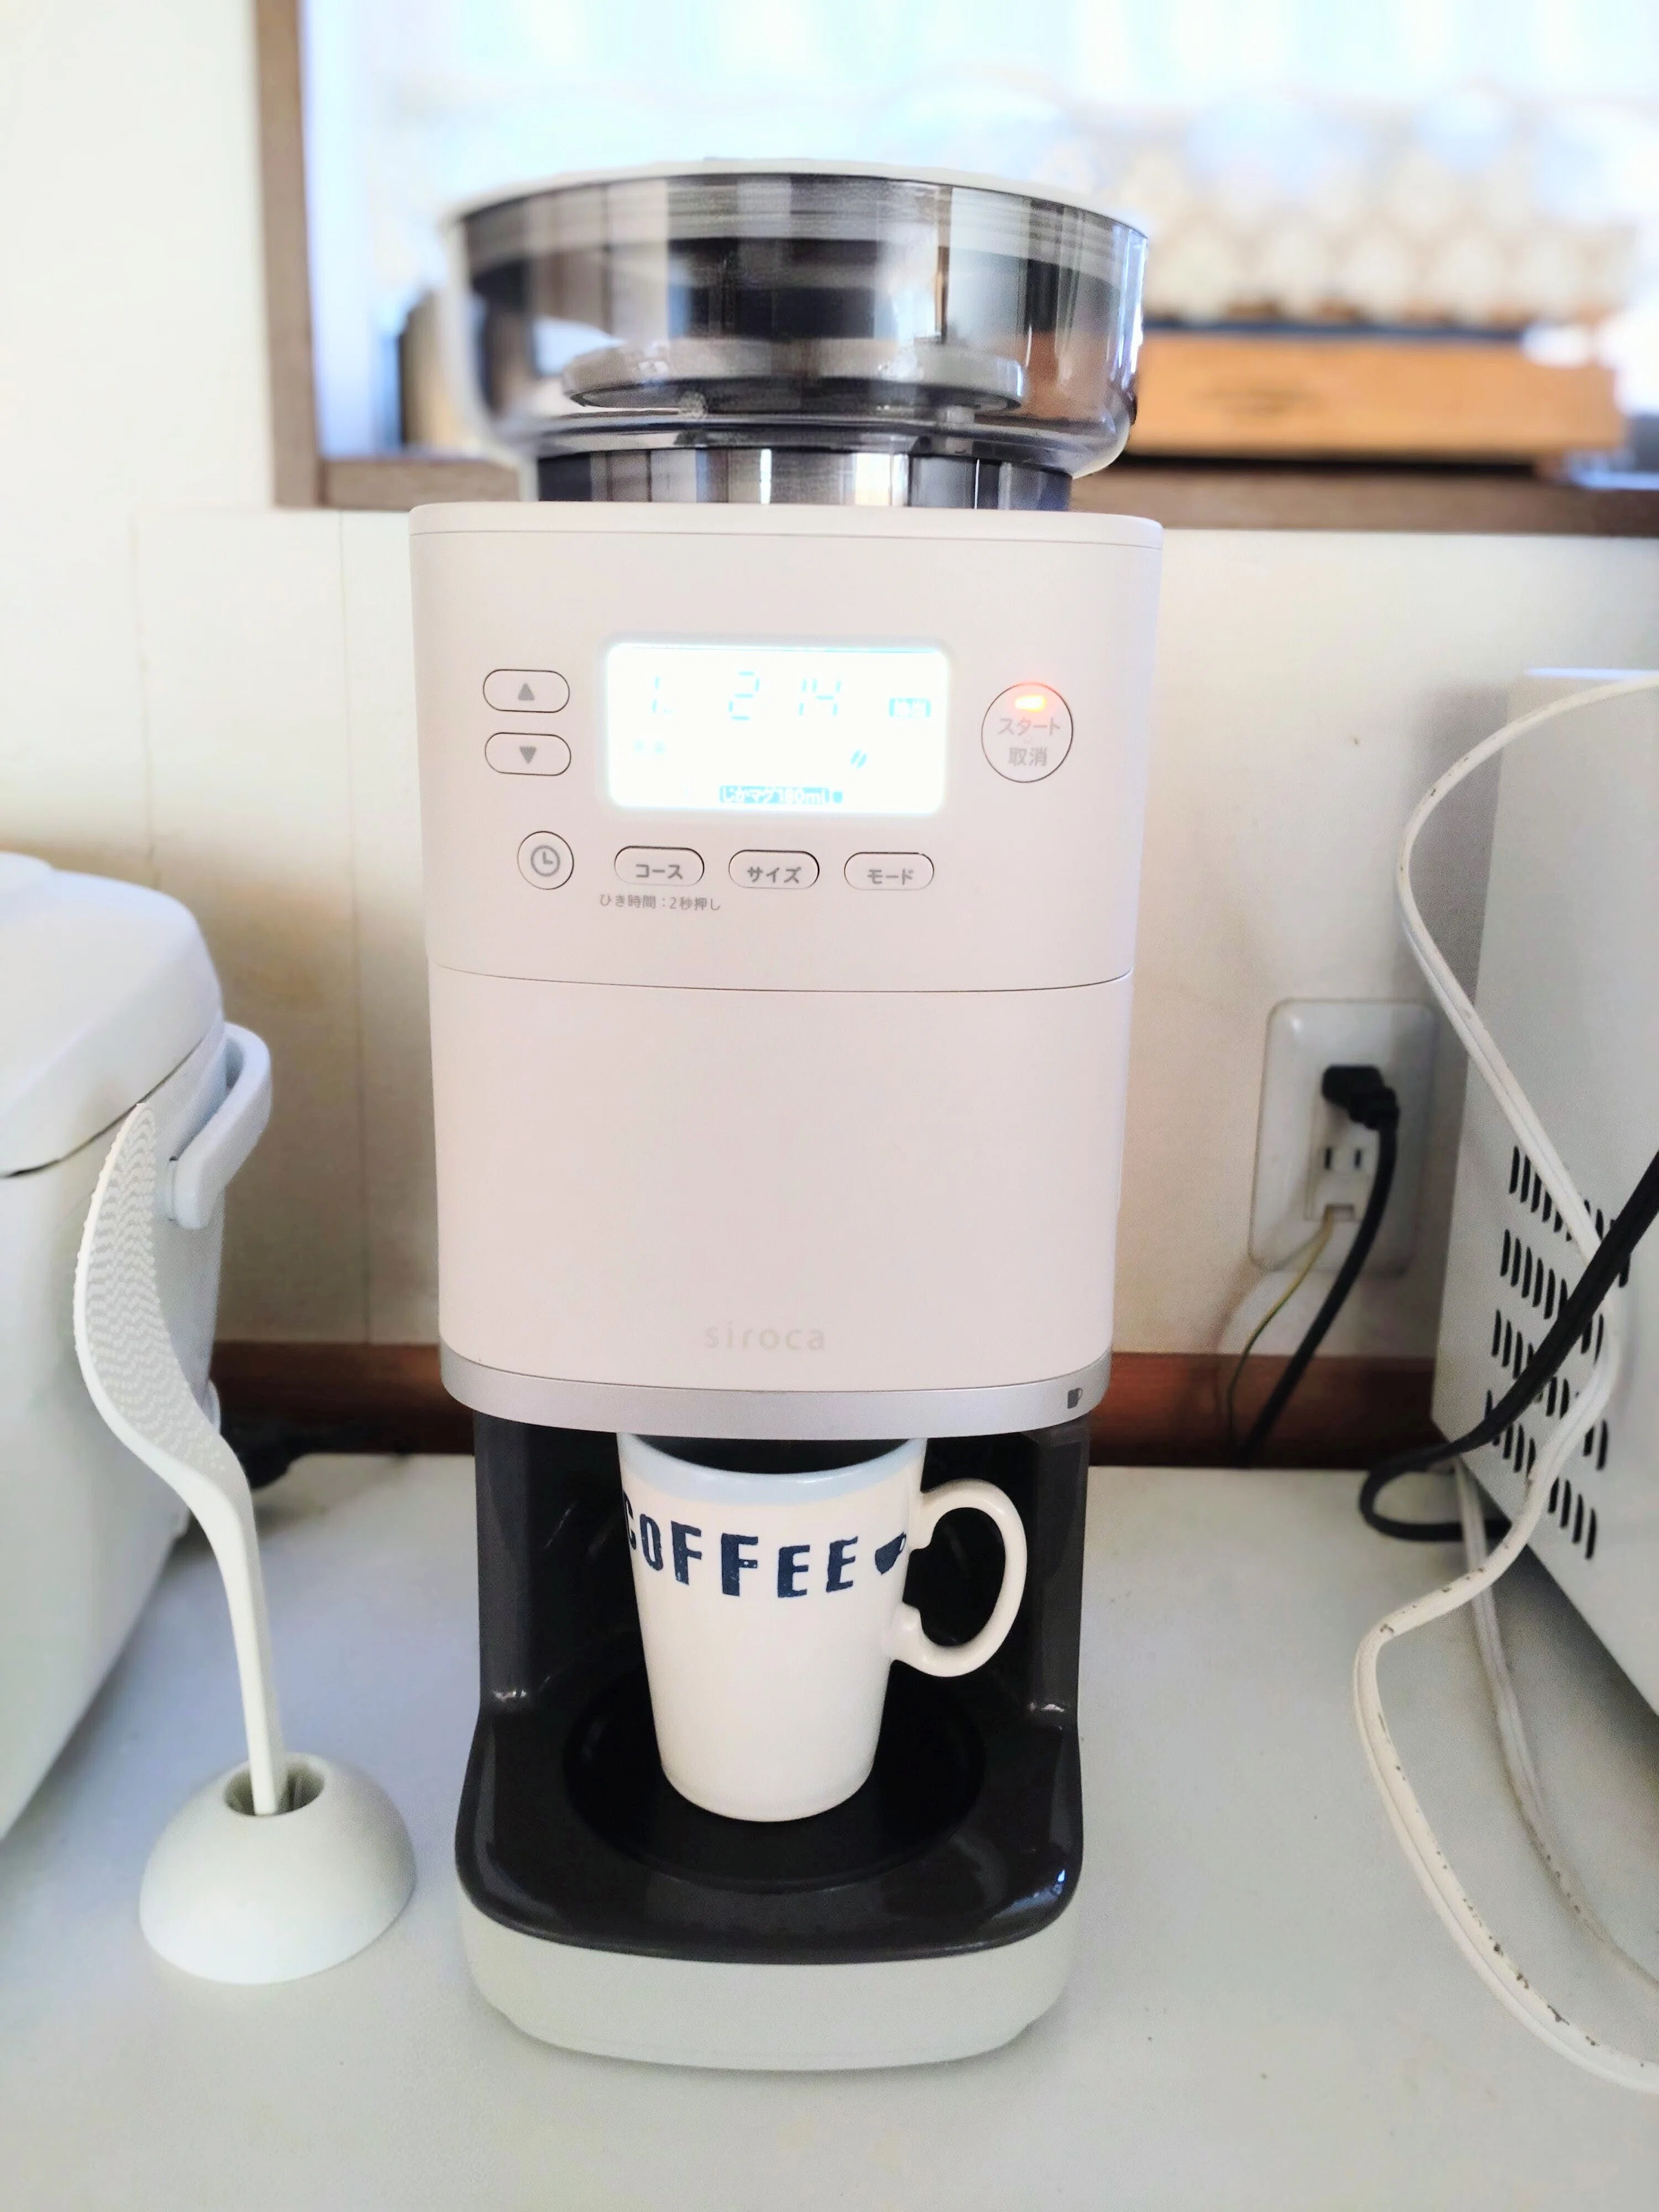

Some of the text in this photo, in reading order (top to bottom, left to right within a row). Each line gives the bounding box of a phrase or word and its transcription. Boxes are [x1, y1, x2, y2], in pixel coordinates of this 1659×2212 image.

[997, 717, 1061, 735] スタート
[1008, 746, 1047, 766] 取消
[635, 864, 683, 879] コース
[747, 866, 801, 884] サイズ
[867, 868, 914, 885] モード
[703, 1320, 825, 1350] siroca
